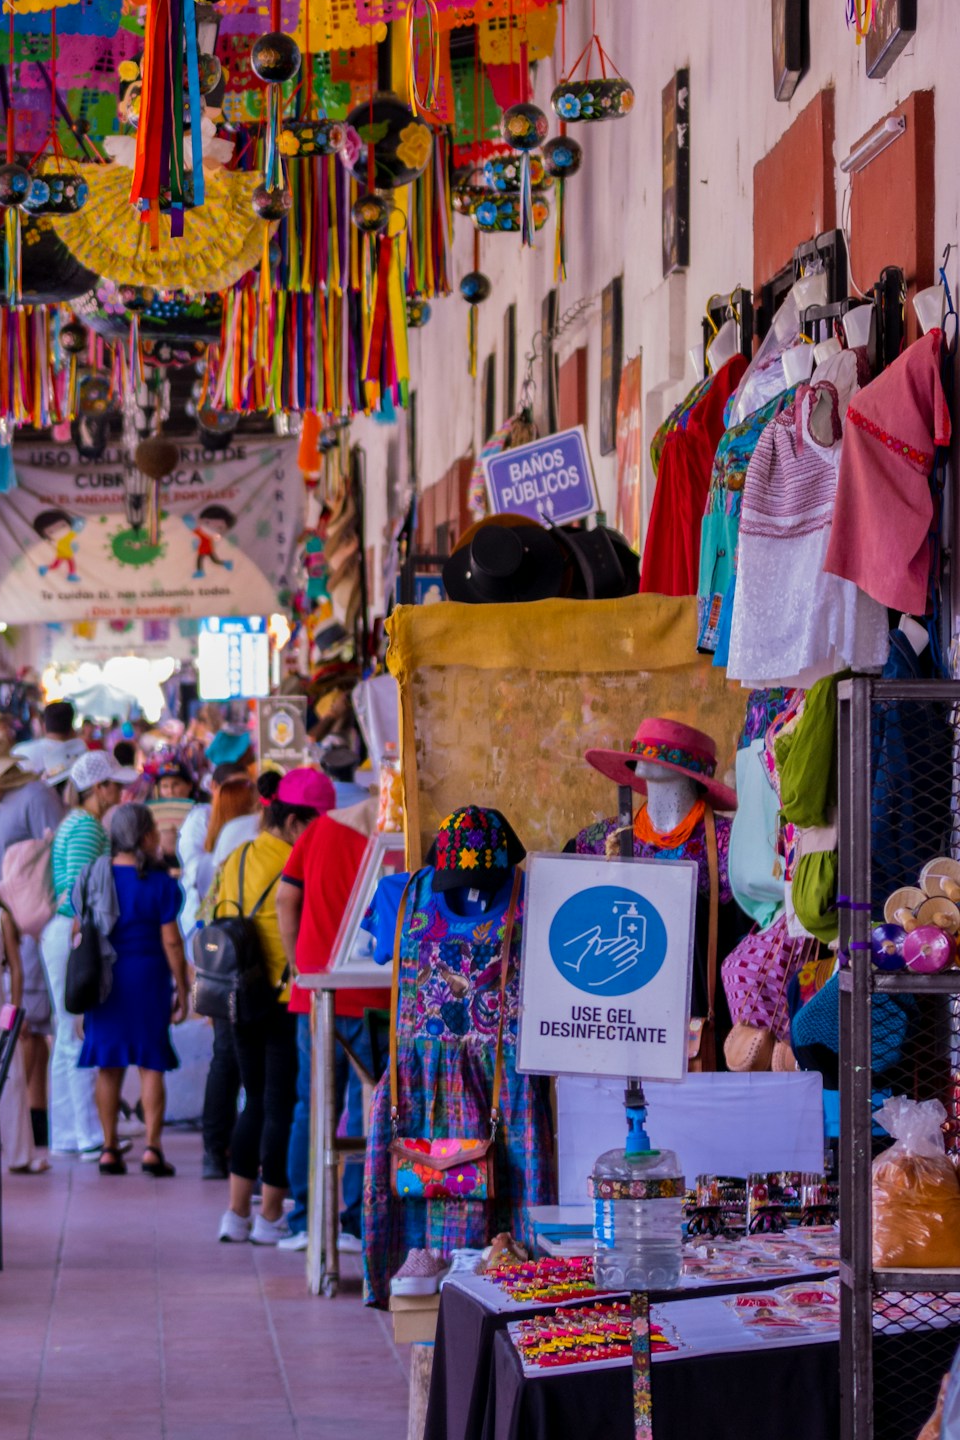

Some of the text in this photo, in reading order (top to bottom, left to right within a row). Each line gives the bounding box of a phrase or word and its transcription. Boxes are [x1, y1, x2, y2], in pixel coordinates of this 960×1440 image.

[30, 446, 247, 466] USO OBLIRIO DE
[509, 448, 564, 482] BAÑOS
[501, 465, 580, 508] PÚBLICOS
[571, 1005, 636, 1025] USE GEL
[540, 1020, 667, 1044] DESINFECTANTE
